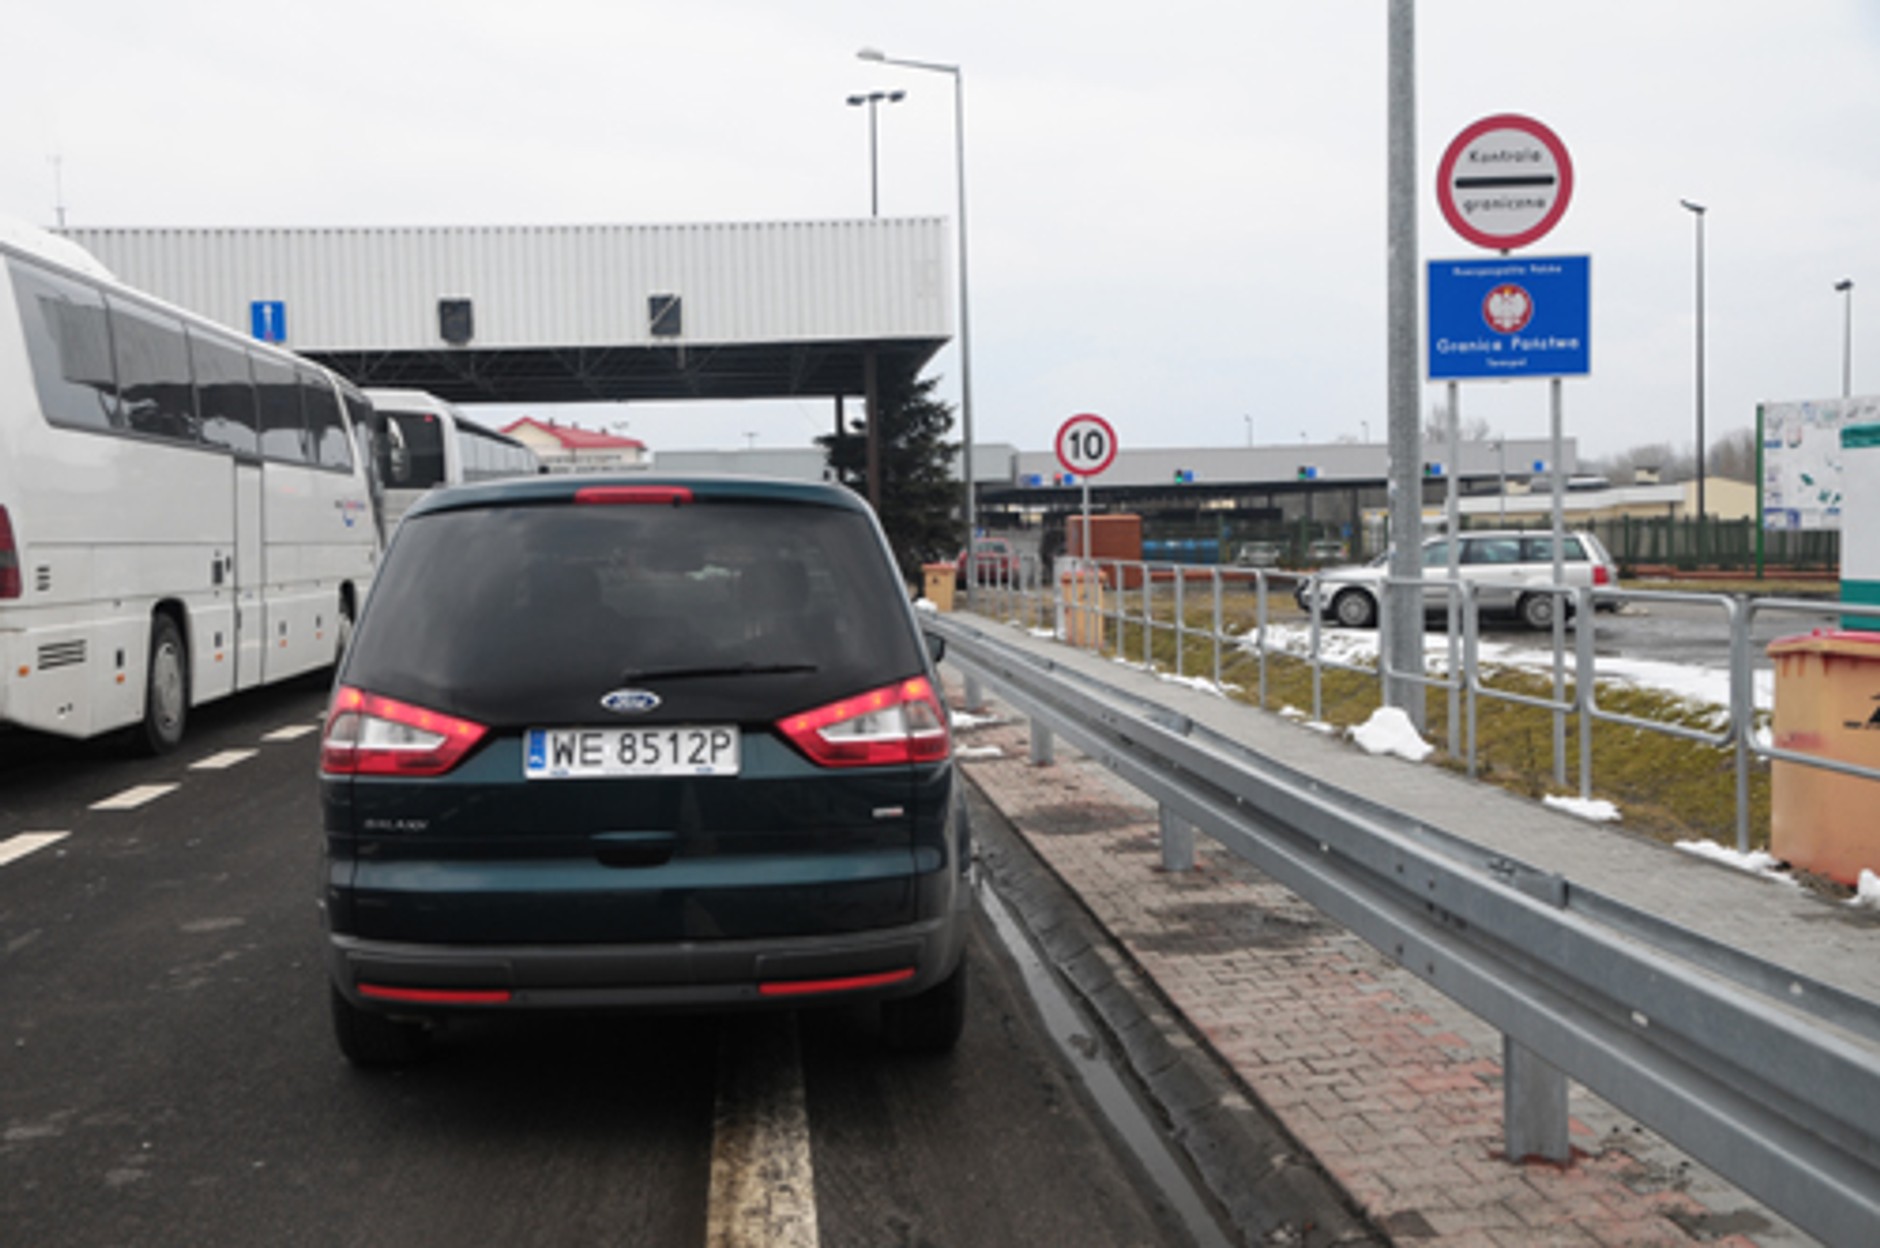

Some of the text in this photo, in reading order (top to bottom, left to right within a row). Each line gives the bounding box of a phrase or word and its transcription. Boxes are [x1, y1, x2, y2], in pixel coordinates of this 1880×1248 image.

[1469, 149, 1542, 163] Kontrola
[1463, 197, 1546, 214] graniczna
[1436, 337, 1502, 354] Granica
[1069, 428, 1104, 461] 10
[552, 729, 731, 766] WE 8512P
